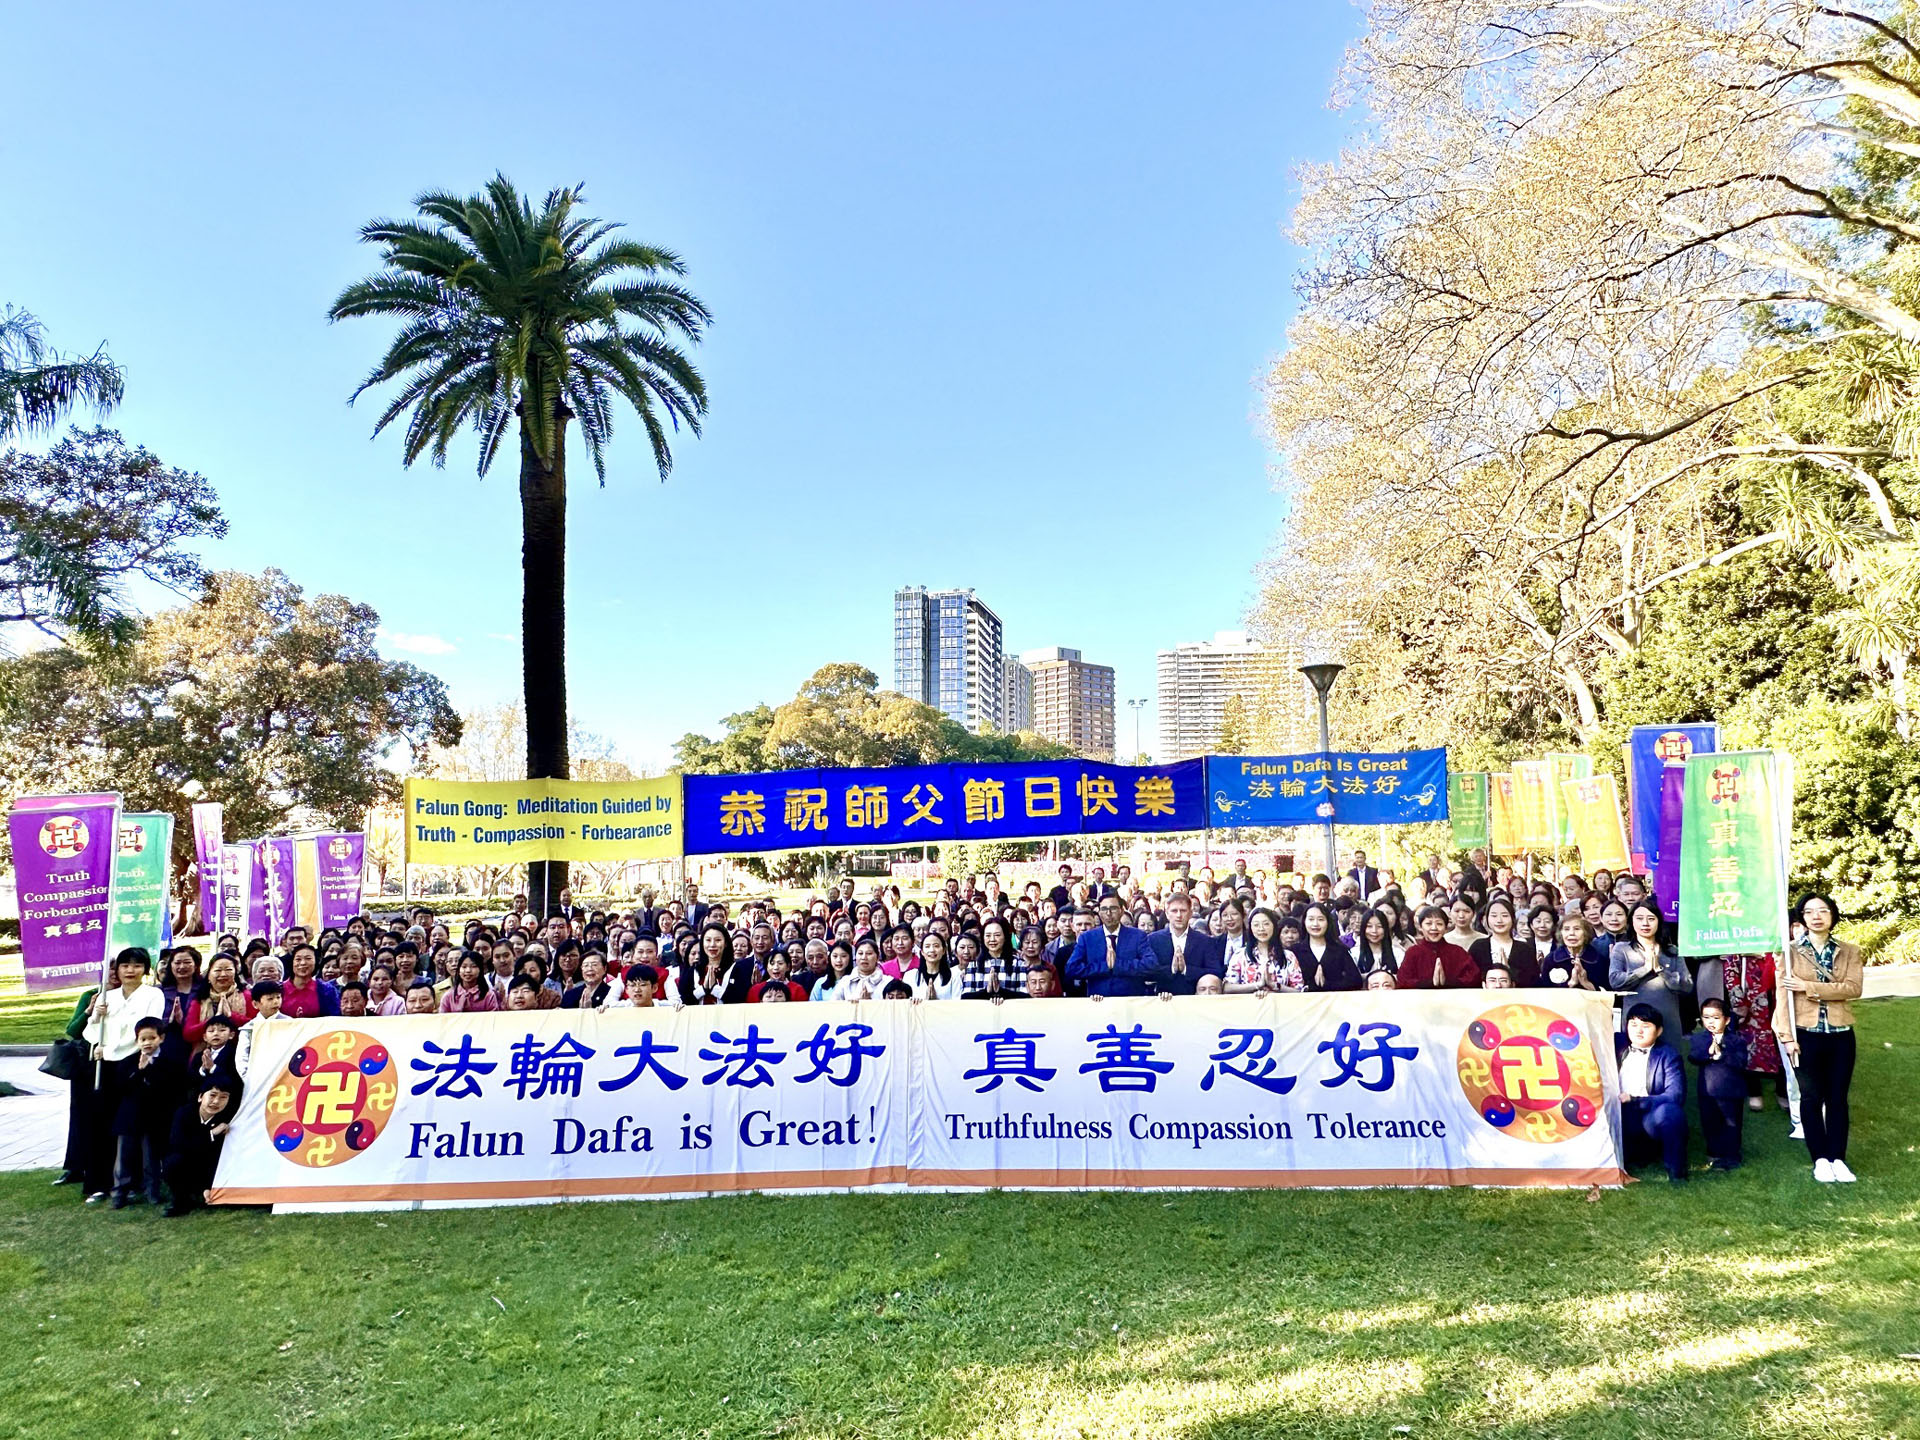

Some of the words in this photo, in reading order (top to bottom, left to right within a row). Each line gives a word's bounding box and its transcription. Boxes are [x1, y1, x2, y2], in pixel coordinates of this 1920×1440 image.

[1241, 762, 1287, 775] Falun
[1293, 758, 1332, 774] Dafa
[1337, 759, 1352, 771] Is
[1358, 758, 1408, 771] Great
[1248, 775, 1401, 798] 法輪大法好
[416, 798, 459, 816] Falun
[464, 800, 508, 819] Gong:
[517, 797, 598, 815] Meditation
[602, 796, 651, 814] Guided
[656, 795, 672, 814] by
[720, 773, 1175, 836] 恭祝師父節日快樂
[416, 825, 456, 843] Truth
[473, 823, 565, 845] Compassion
[582, 822, 672, 841] Forbearance
[46, 870, 91, 885] Truth
[1707, 819, 1744, 920] 真善忍
[1696, 928, 1728, 941] Falun
[1732, 925, 1763, 938] Dafa
[41, 966, 80, 979] Falun
[84, 961, 105, 973] Da
[410, 1022, 887, 1100] 法輪大法好
[962, 1021, 1420, 1095] 真善忍好
[405, 1121, 525, 1160] Falun
[551, 1114, 653, 1154] Dafa
[680, 1113, 713, 1150] is
[739, 1105, 877, 1148] Great!
[945, 1112, 1113, 1141] Truthfulness
[1129, 1112, 1293, 1148] Compassion
[1306, 1112, 1446, 1140] Tolerance
